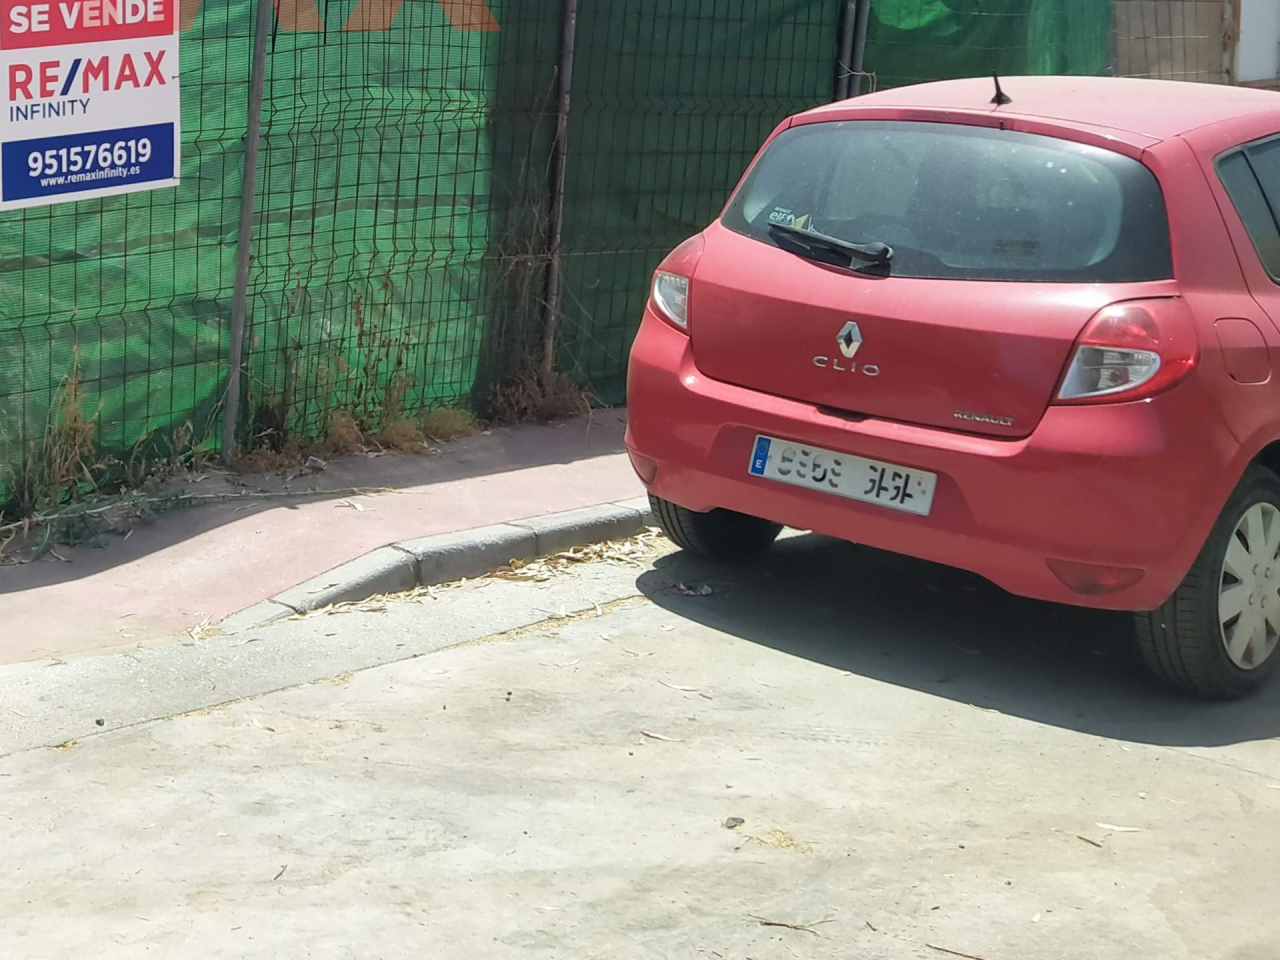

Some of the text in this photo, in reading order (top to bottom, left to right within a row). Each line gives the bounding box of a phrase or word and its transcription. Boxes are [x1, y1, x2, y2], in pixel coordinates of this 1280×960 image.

[9, 3, 50, 34] SE
[8, 50, 167, 101] RE/MAX
[10, 98, 91, 122] INFINITY
[27, 138, 152, 177] 951576619
[40, 165, 140, 187] www.remaxinfinity.es
[812, 355, 880, 376] CLIO
[755, 459, 762, 469] E
